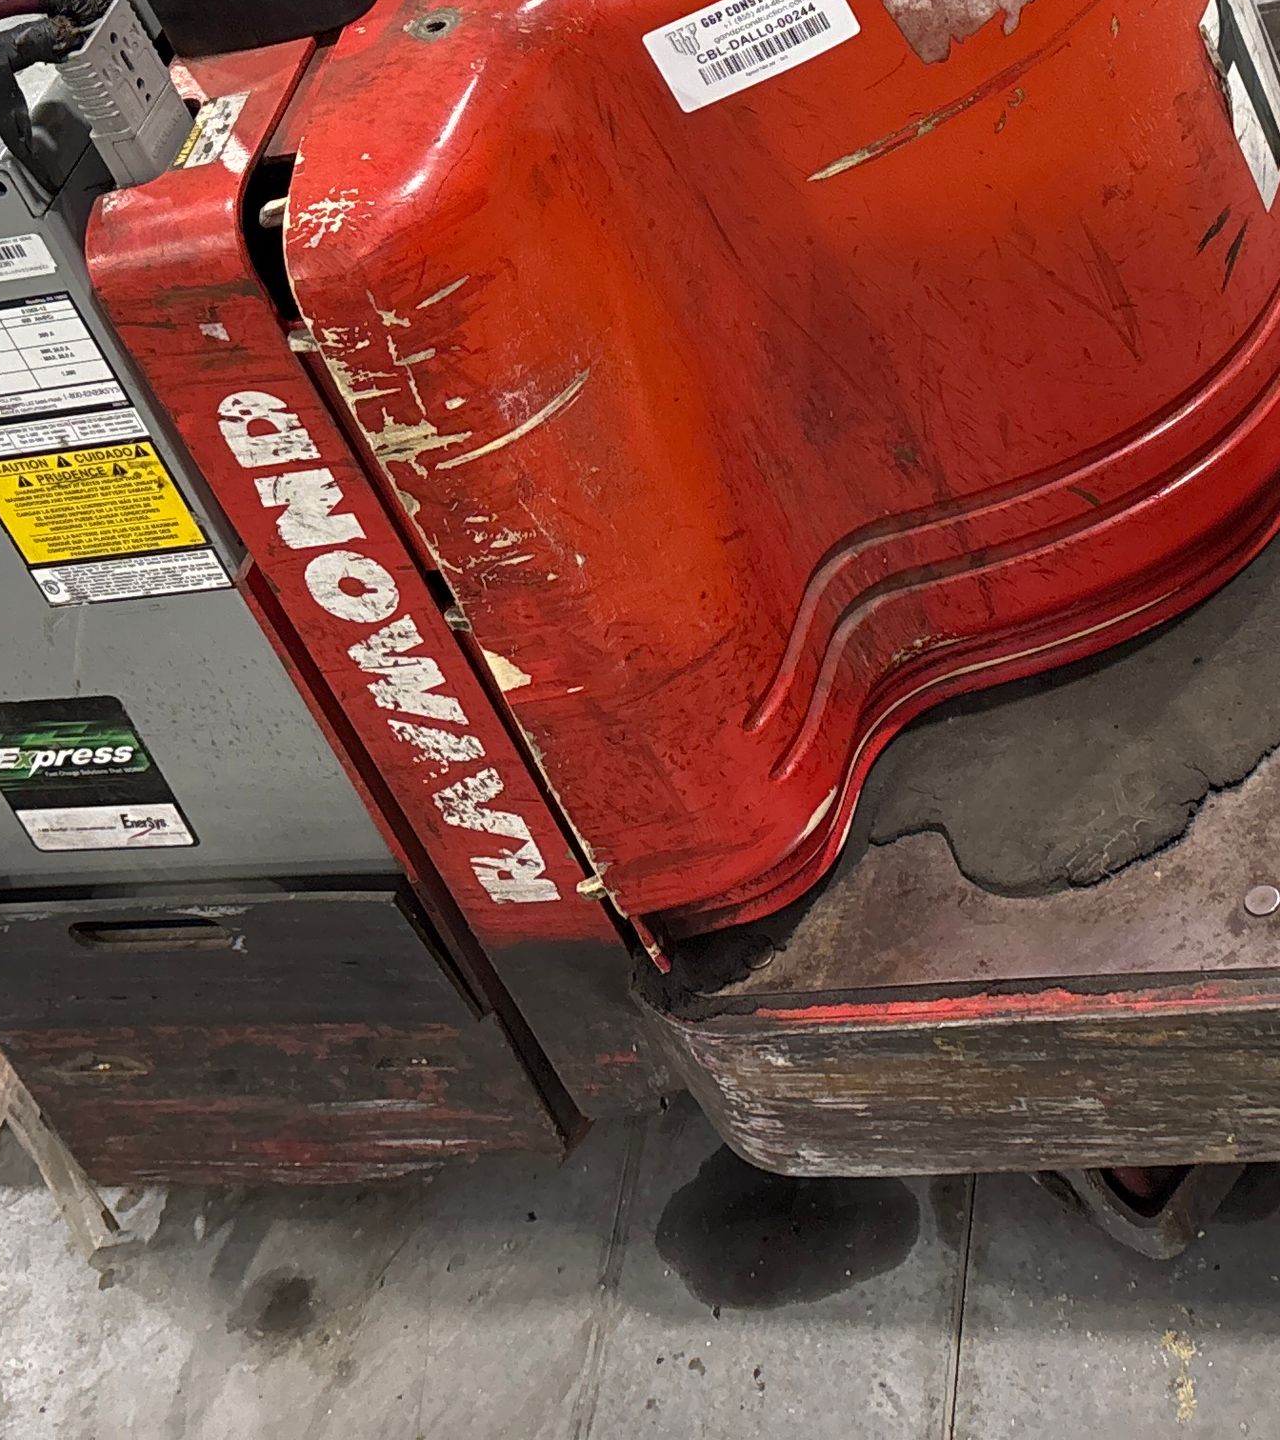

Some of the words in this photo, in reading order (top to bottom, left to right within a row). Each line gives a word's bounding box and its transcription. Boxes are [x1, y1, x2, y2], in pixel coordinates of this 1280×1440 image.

[700, 10, 724, 29] G&P
[73, 446, 133, 465] CUIDADO
[35, 466, 107, 485] PRUDENCE
[216, 389, 562, 905] RAYMOND
[120, 813, 170, 832] EnerSys
